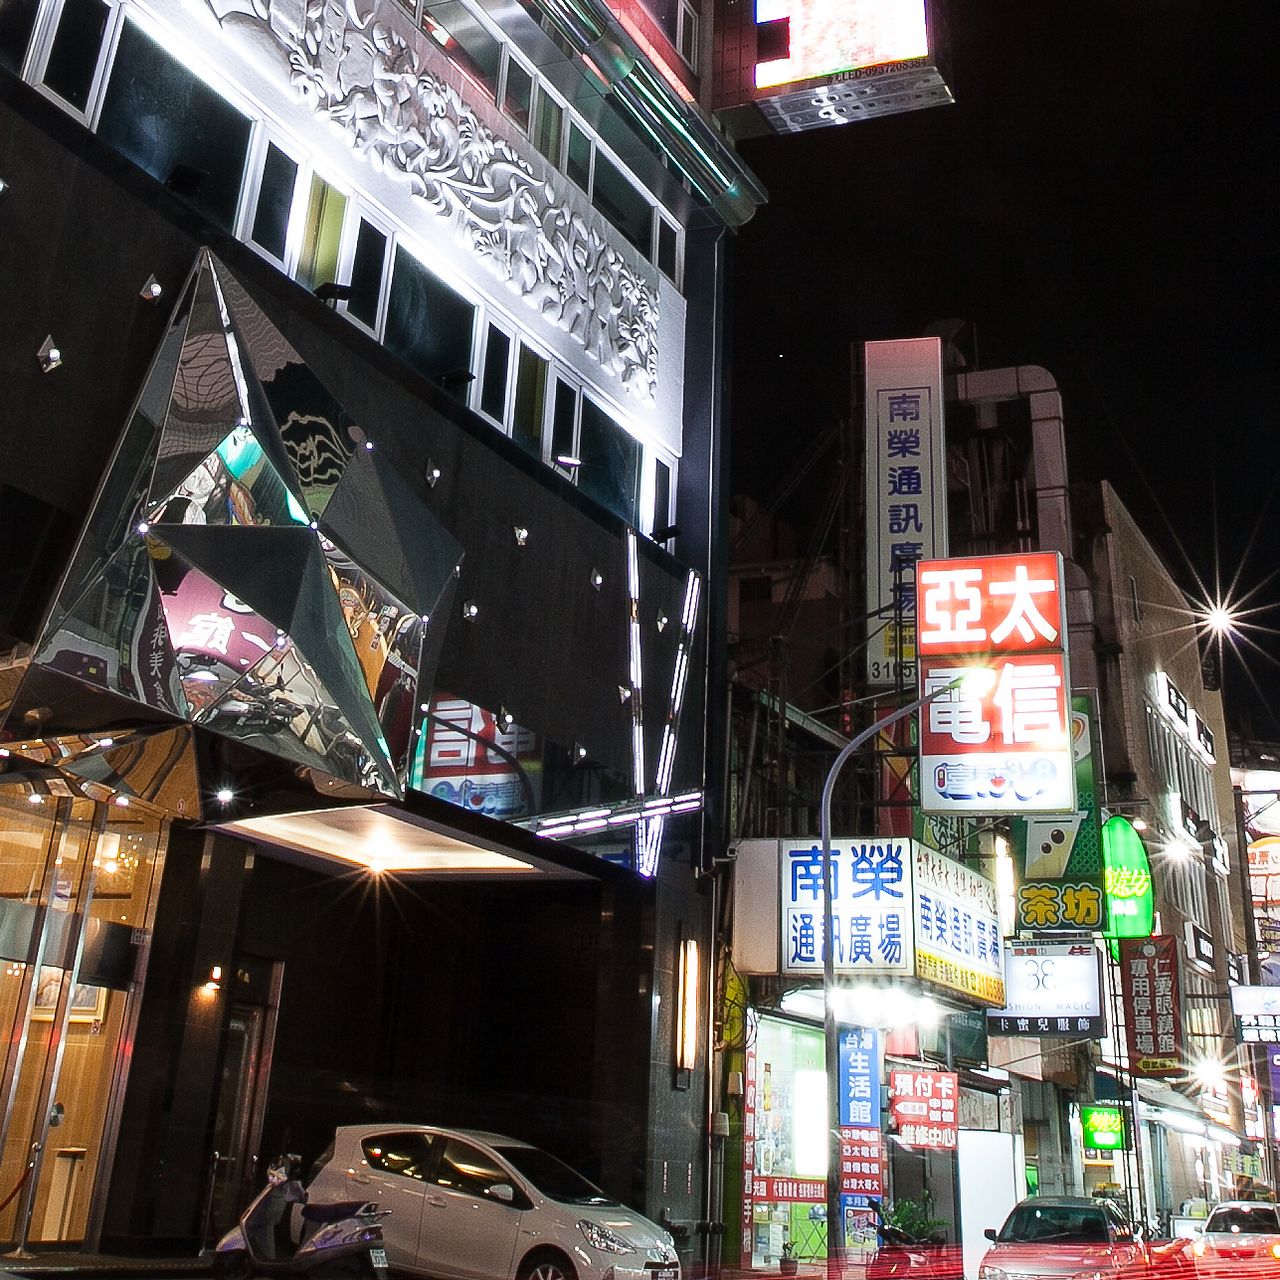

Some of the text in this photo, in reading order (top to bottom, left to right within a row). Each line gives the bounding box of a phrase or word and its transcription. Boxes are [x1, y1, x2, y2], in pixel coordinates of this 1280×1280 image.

[921, 565, 1058, 645] 亞太
[925, 663, 1064, 747] 電信
[789, 844, 904, 902] 南榮
[1021, 885, 1100, 926] 茶坊
[1130, 959, 1154, 1055] 專用停車場
[1153, 959, 1175, 1053] 仁愛眼鏡館
[848, 1052, 872, 1123] 生活館
[895, 1074, 955, 1098] 預付卡
